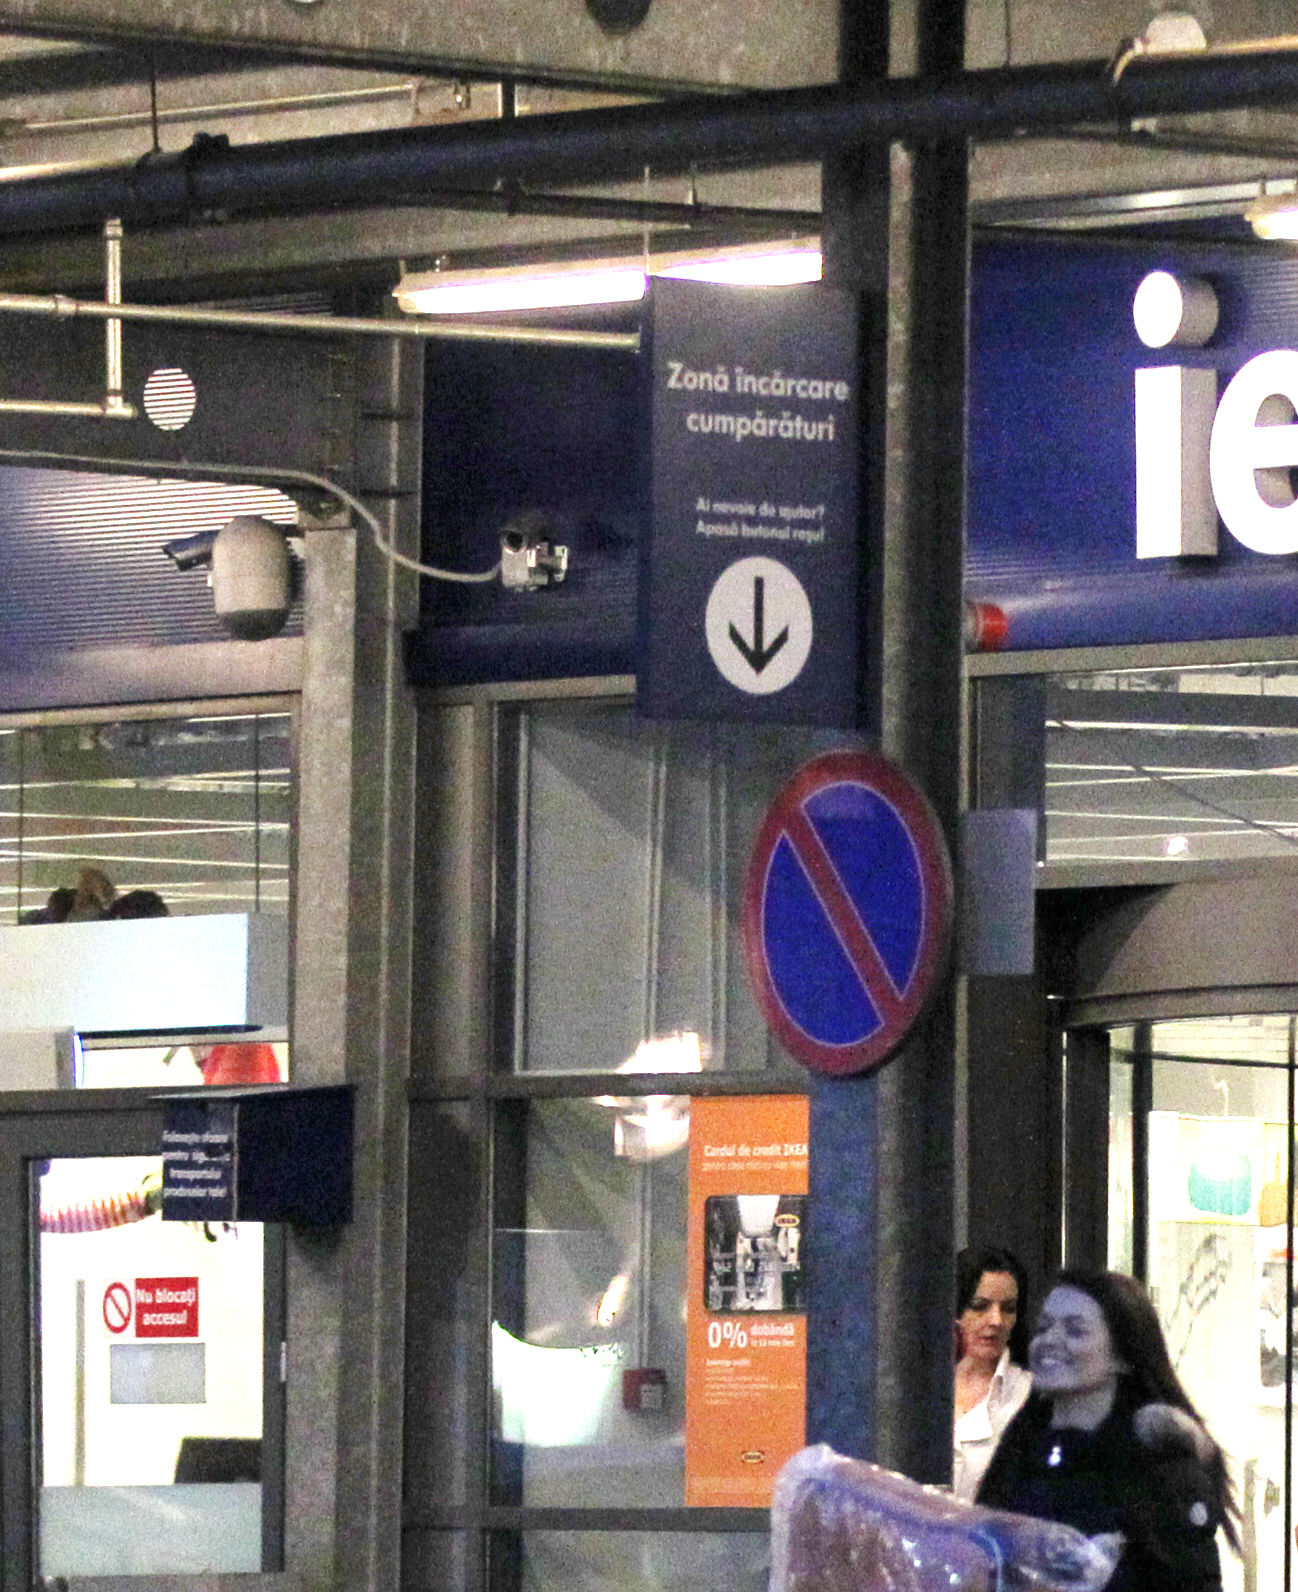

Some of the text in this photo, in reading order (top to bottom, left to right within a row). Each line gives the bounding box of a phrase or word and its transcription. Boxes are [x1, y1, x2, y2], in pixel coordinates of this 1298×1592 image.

[686, 410, 835, 442] cumpărături
[135, 1288, 152, 1304] Nu
[708, 1321, 748, 1348] 0%
